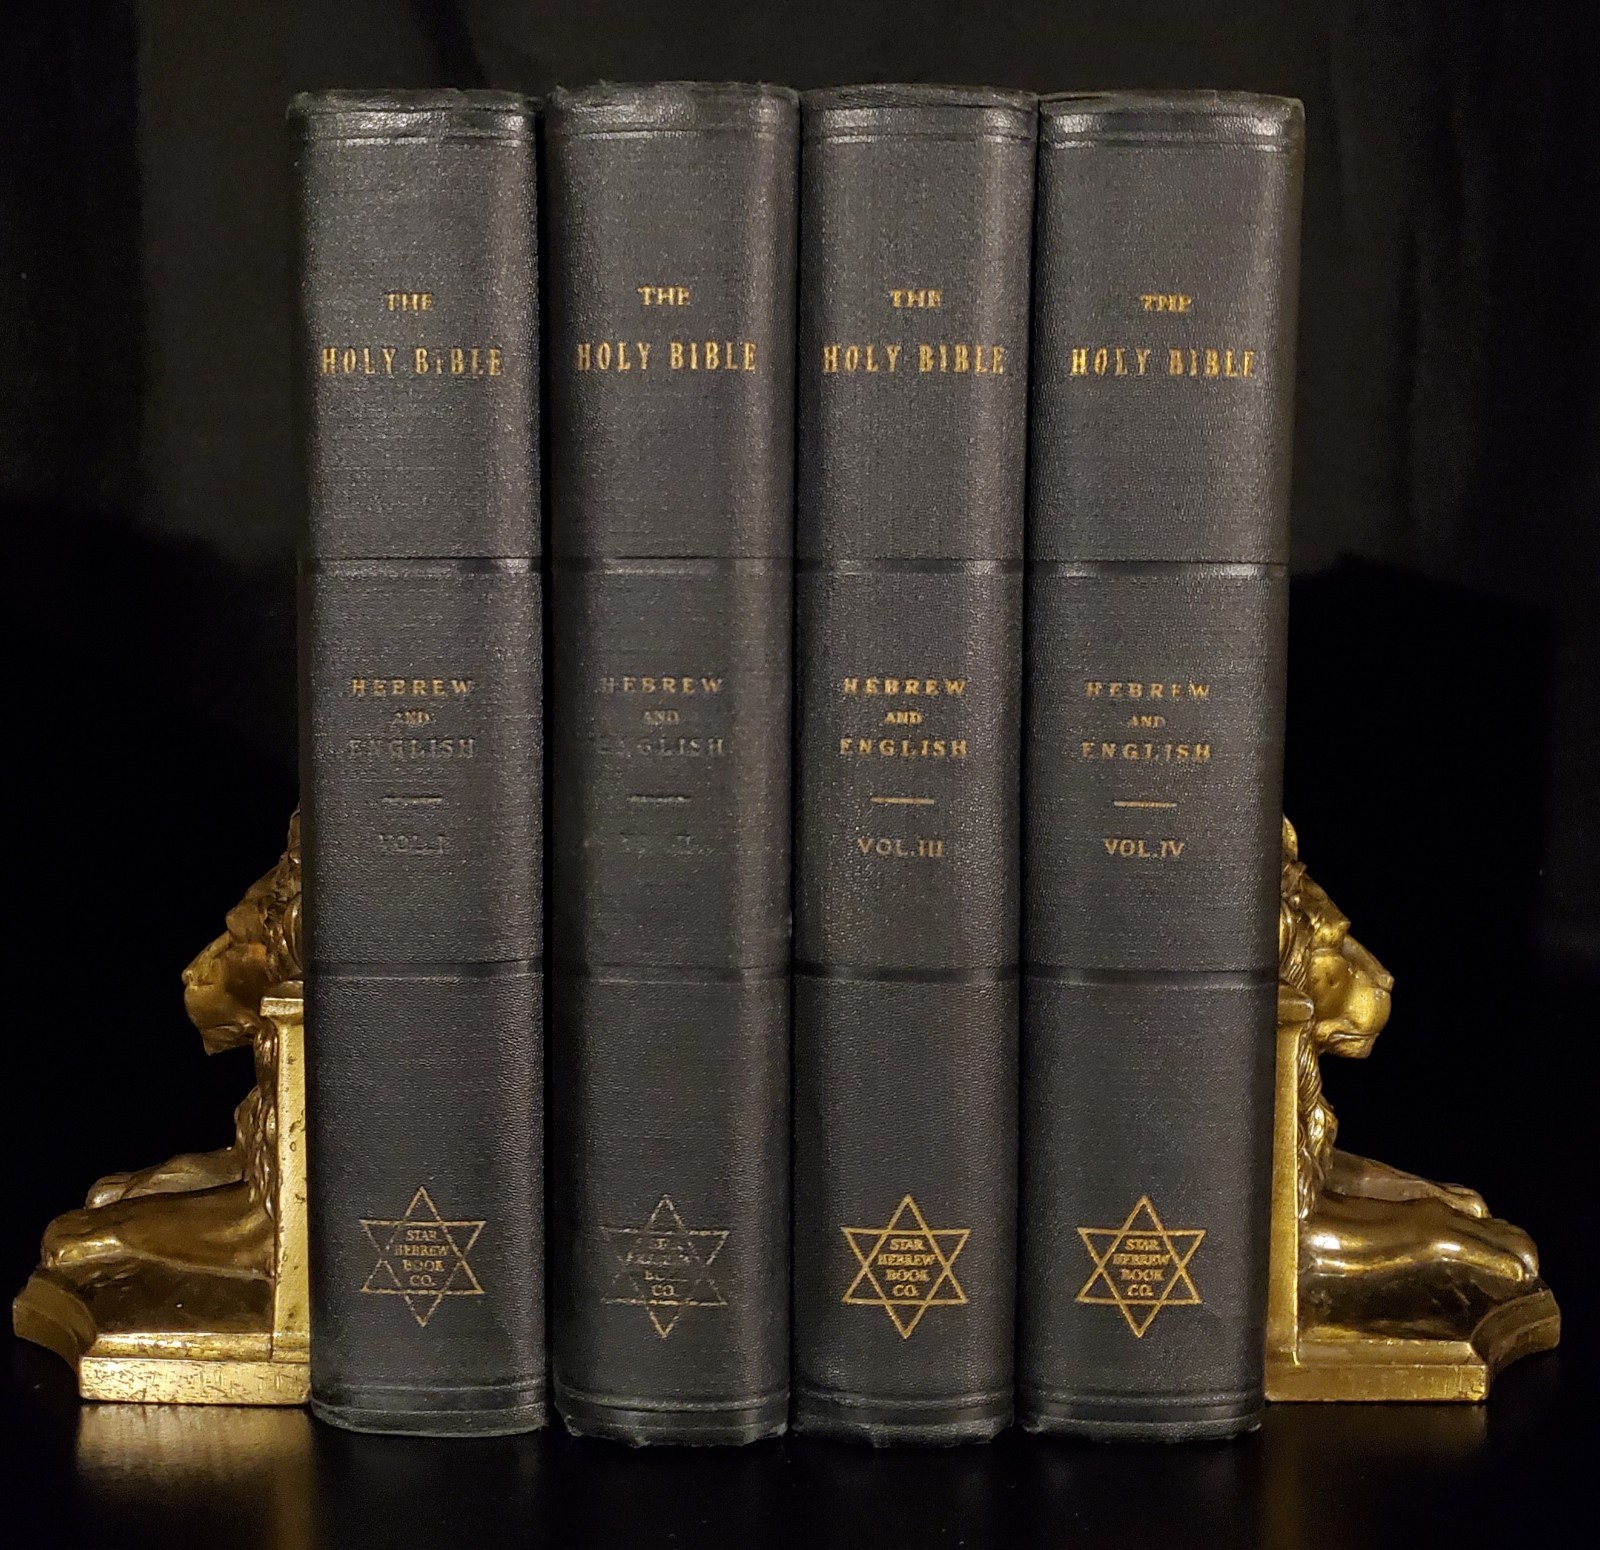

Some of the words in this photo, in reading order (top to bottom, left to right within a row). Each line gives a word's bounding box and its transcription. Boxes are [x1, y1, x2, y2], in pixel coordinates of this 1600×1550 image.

[387, 292, 433, 311] THE
[639, 286, 691, 306] THE
[889, 289, 942, 308] THE
[321, 347, 396, 375] HOLY
[414, 347, 503, 377] BIBLE
[576, 342, 651, 372] HOLY
[669, 342, 758, 372] BIBLE
[822, 344, 901, 373] HOLY
[918, 345, 1005, 374] BIBLE
[1070, 347, 1151, 377] HOLY
[1168, 348, 1257, 379] BIBLE
[351, 678, 474, 697] HEBREW
[600, 676, 724, 695] HEBREW
[842, 677, 967, 697] HEBREW
[1085, 681, 1211, 698] HEBREW
[642, 709, 681, 726] AND
[884, 711, 923, 725] AND
[1128, 715, 1167, 729] AND
[839, 738, 968, 759] ENGLISH
[1081, 741, 1212, 762] ENGLISH
[406, 1229, 437, 1242] STAR
[889, 1239, 926, 1251] STAR
[1125, 1239, 1160, 1251] STAR
[1121, 1268, 1164, 1281] BOOK
